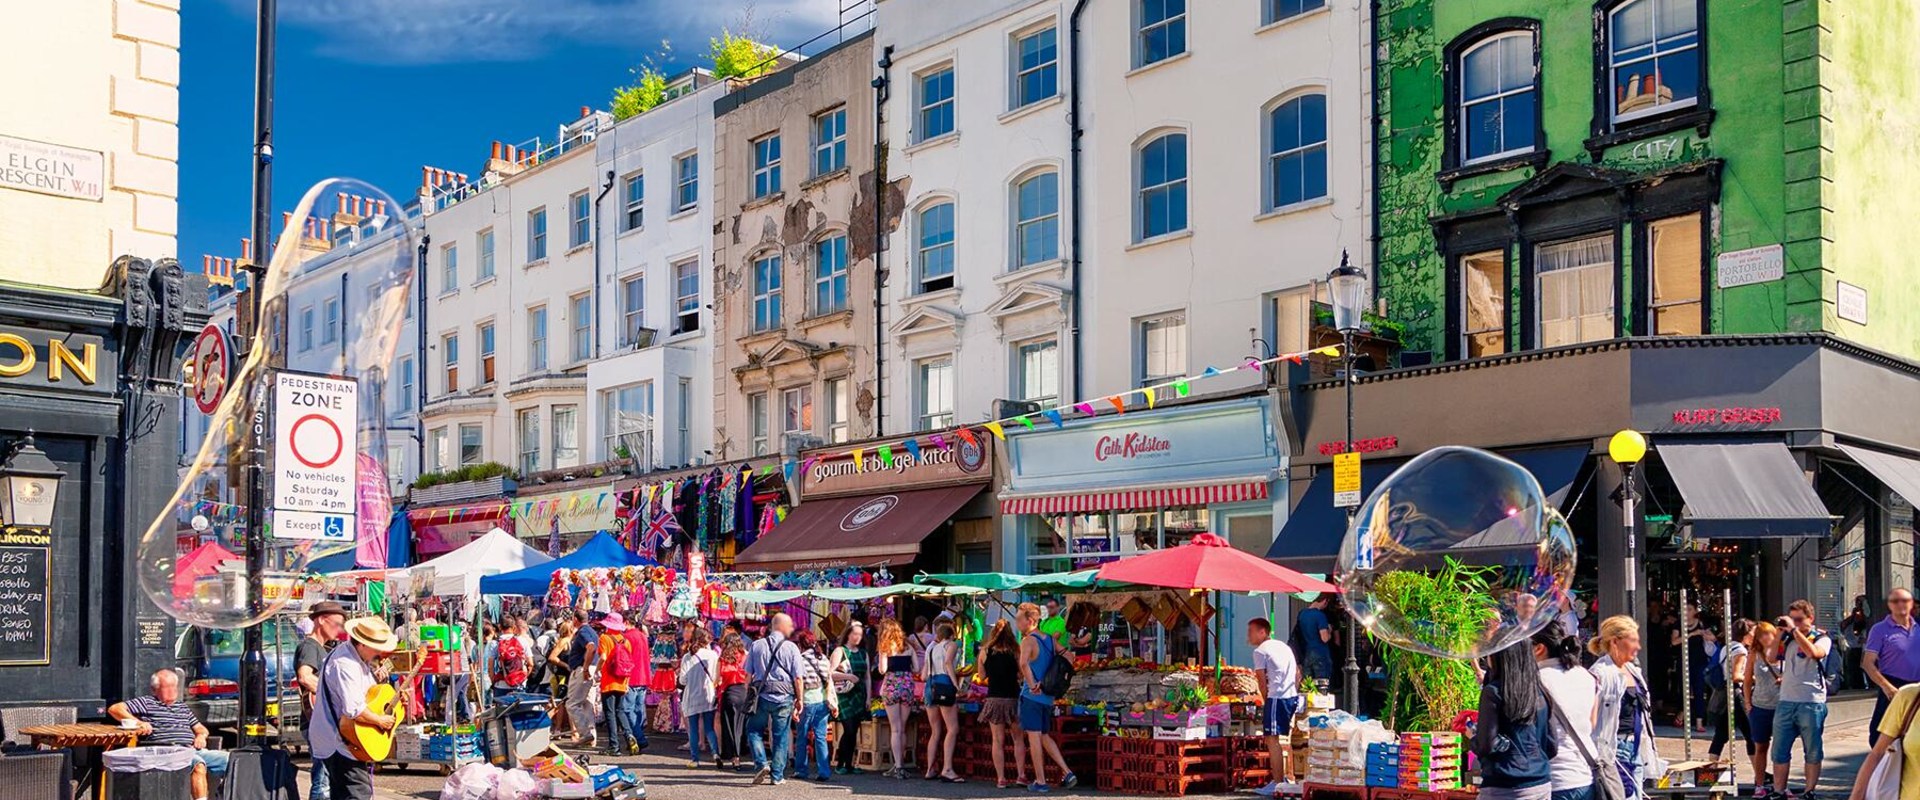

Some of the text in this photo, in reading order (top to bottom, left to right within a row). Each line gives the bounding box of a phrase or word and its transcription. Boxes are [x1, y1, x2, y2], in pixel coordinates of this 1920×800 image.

[1632, 138, 1678, 161] CITY
[8, 152, 75, 177] ELGIN
[1719, 259, 1782, 277] PORTOBELLO
[0, 333, 97, 385] ON
[281, 377, 353, 393] PEDESTRIAN
[291, 391, 342, 410] ZONE
[1672, 409, 1718, 424] KURT
[963, 446, 979, 459] gbk
[1095, 432, 1171, 462] Cath Kidston
[920, 445, 955, 467] kitch
[286, 470, 345, 483] No vehicles
[292, 484, 339, 497] Saturday
[284, 496, 296, 505] 10
[321, 499, 328, 507] 4
[286, 520, 321, 531] Except
